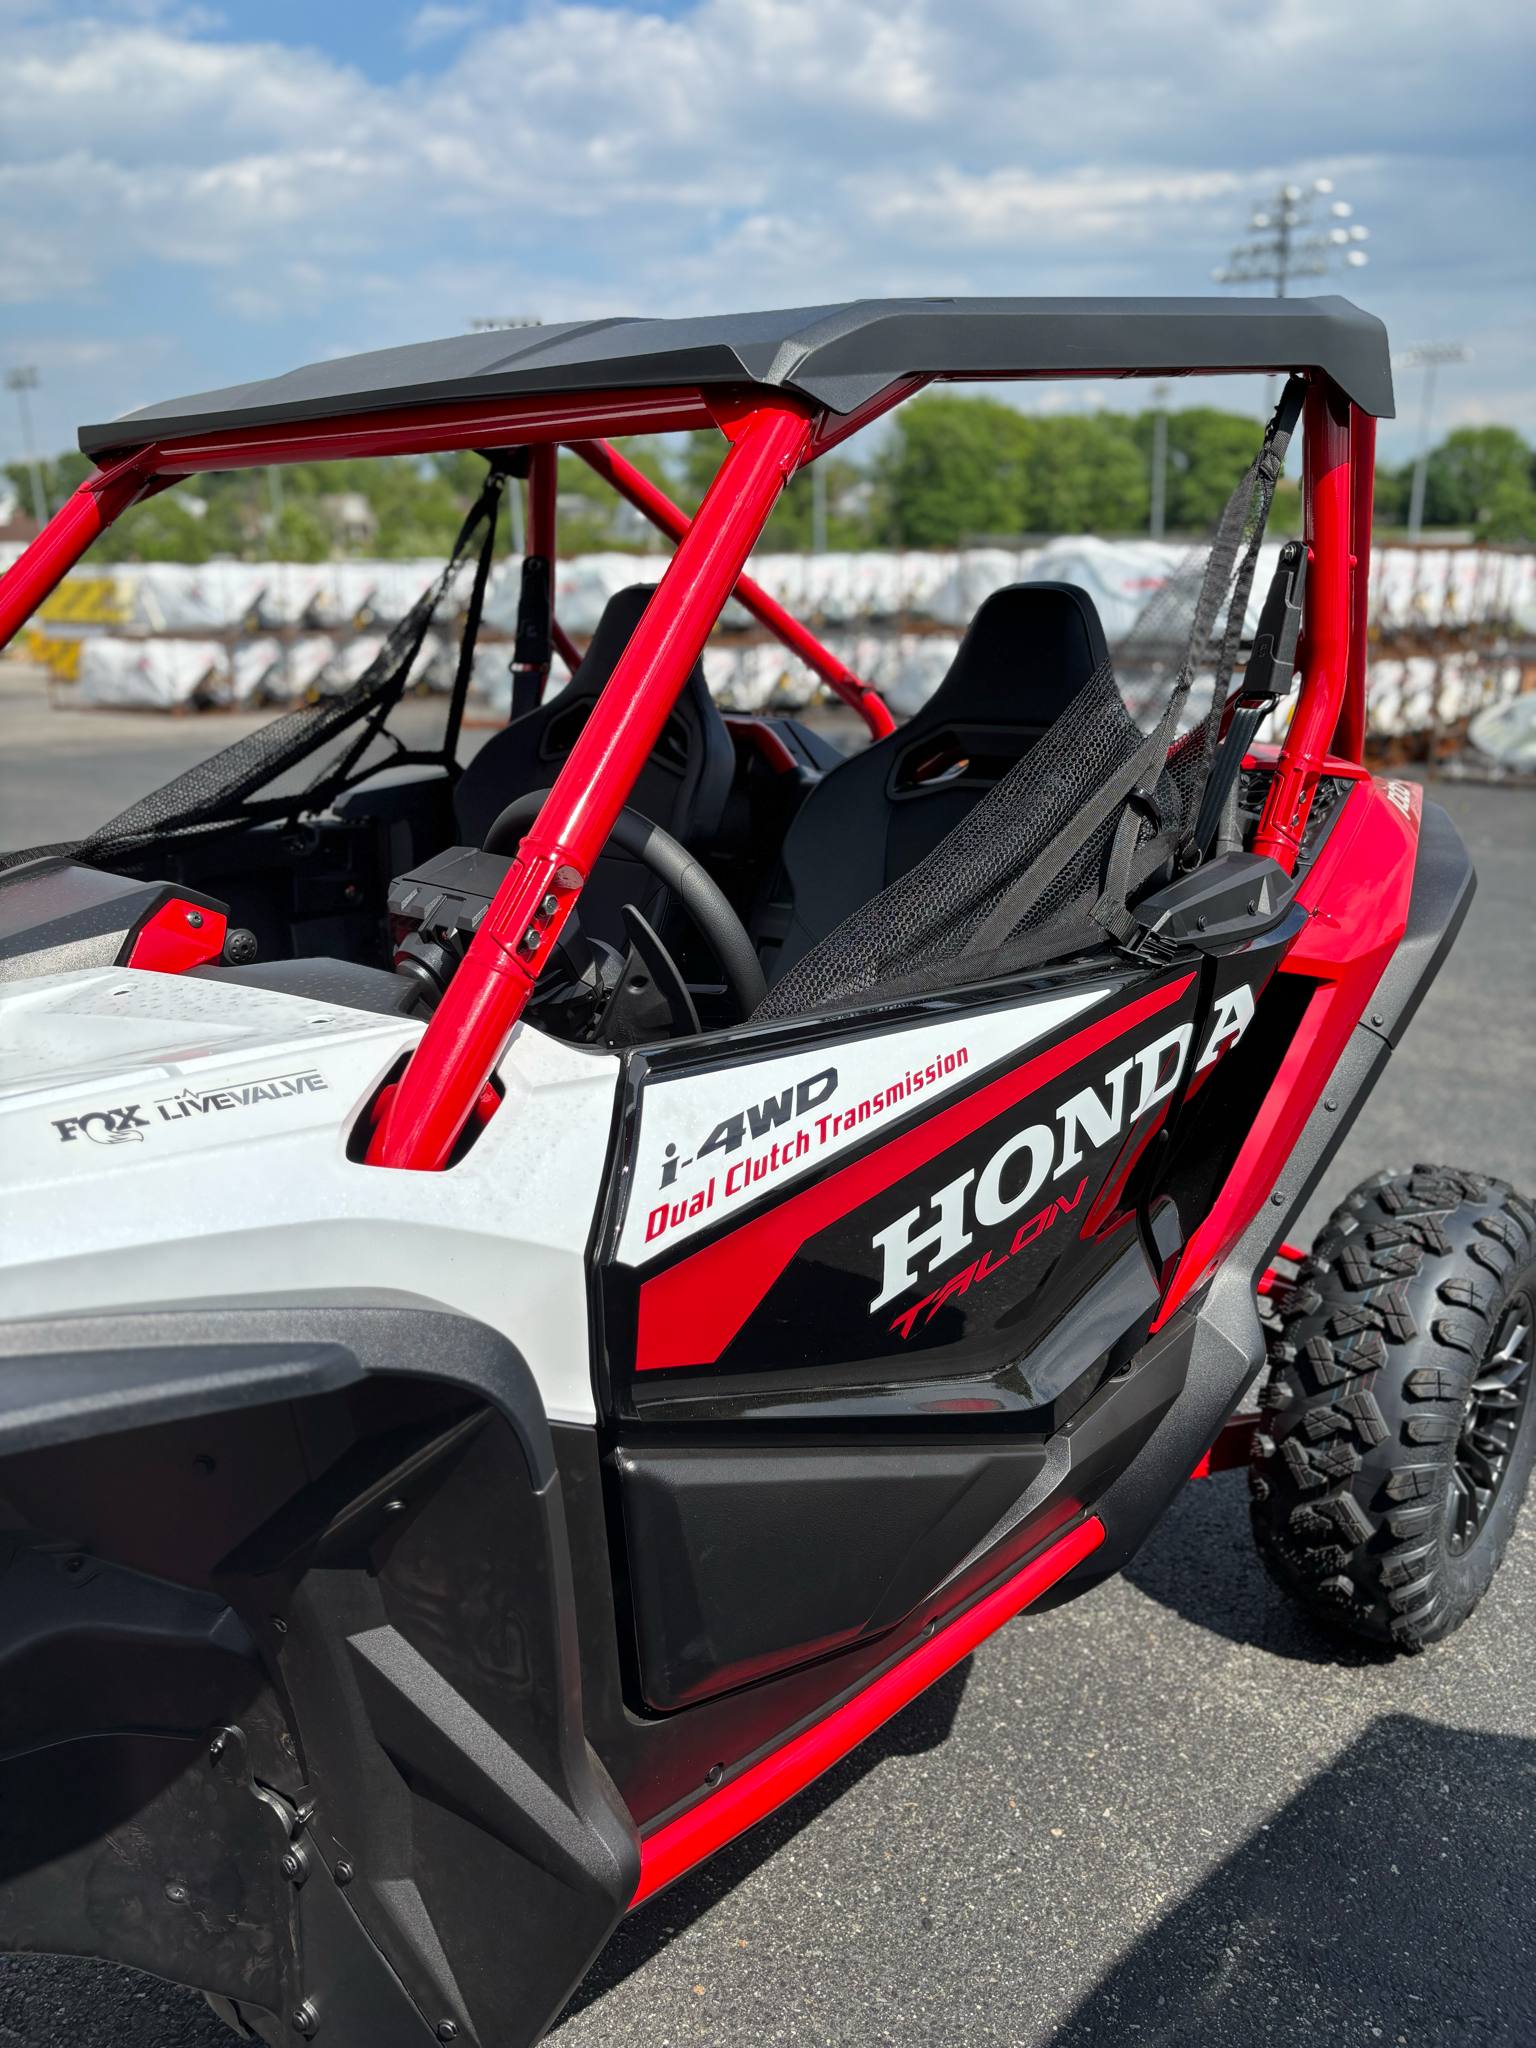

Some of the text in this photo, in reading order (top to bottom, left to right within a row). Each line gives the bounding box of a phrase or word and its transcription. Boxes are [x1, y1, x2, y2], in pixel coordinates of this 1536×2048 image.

[51, 1104, 151, 1144] FOX
[645, 1046, 969, 1244] Dual Clutch Transmission
[659, 1066, 839, 1191] i-4WD
[869, 983, 1256, 1314] HONDA
[888, 1175, 1089, 1340] TALON
